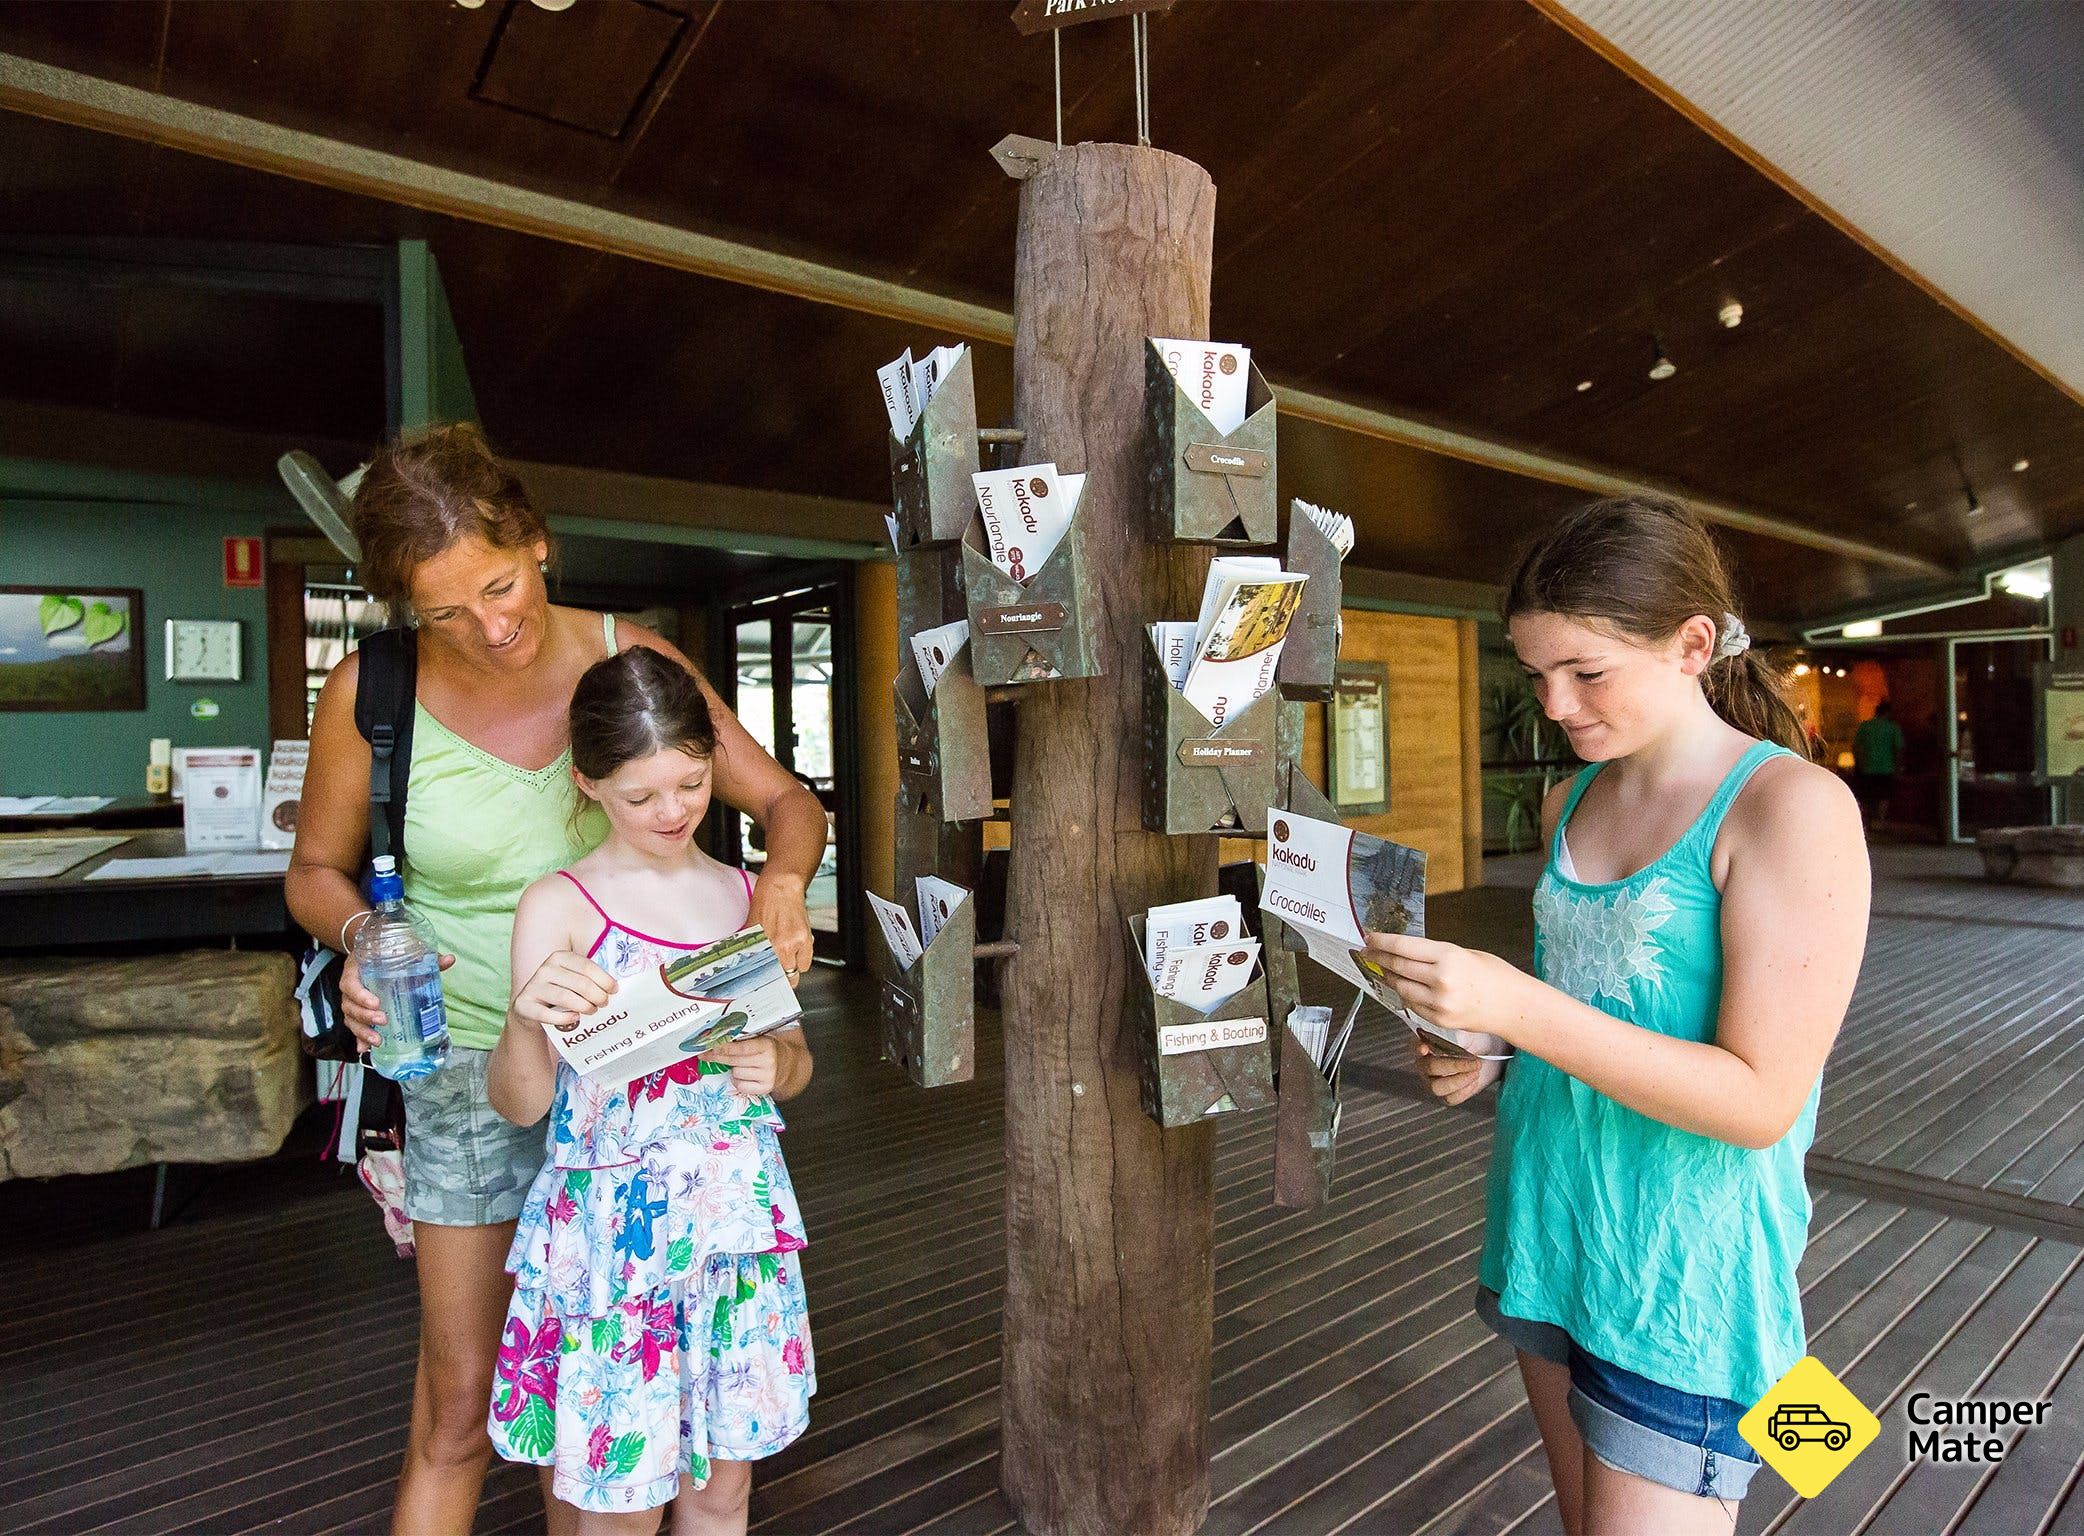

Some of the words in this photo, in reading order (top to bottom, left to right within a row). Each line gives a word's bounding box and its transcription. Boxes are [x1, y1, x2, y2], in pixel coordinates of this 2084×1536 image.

[882, 376, 897, 412] Ubirr
[899, 364, 914, 425] kakadu
[1202, 351, 1217, 410] kakadu
[979, 486, 1007, 563] Nourlangie
[1012, 478, 1038, 534] kakadu
[1193, 747, 1222, 759] Holiday
[1224, 747, 1252, 757] Planner
[1272, 844, 1317, 872] kakadu
[1269, 889, 1327, 924] Crocodiles
[1153, 931, 1169, 971] Fishing
[1162, 959, 1183, 990] Fishing
[1202, 952, 1227, 991] kakadu
[562, 1009, 629, 1048] kakadu
[584, 1035, 633, 1065] Fishing
[634, 1028, 647, 1040] &
[648, 1002, 701, 1032] Boating
[1165, 1032, 1207, 1047] Fishing
[1210, 1028, 1220, 1042] &
[1223, 1025, 1265, 1041] Boating
